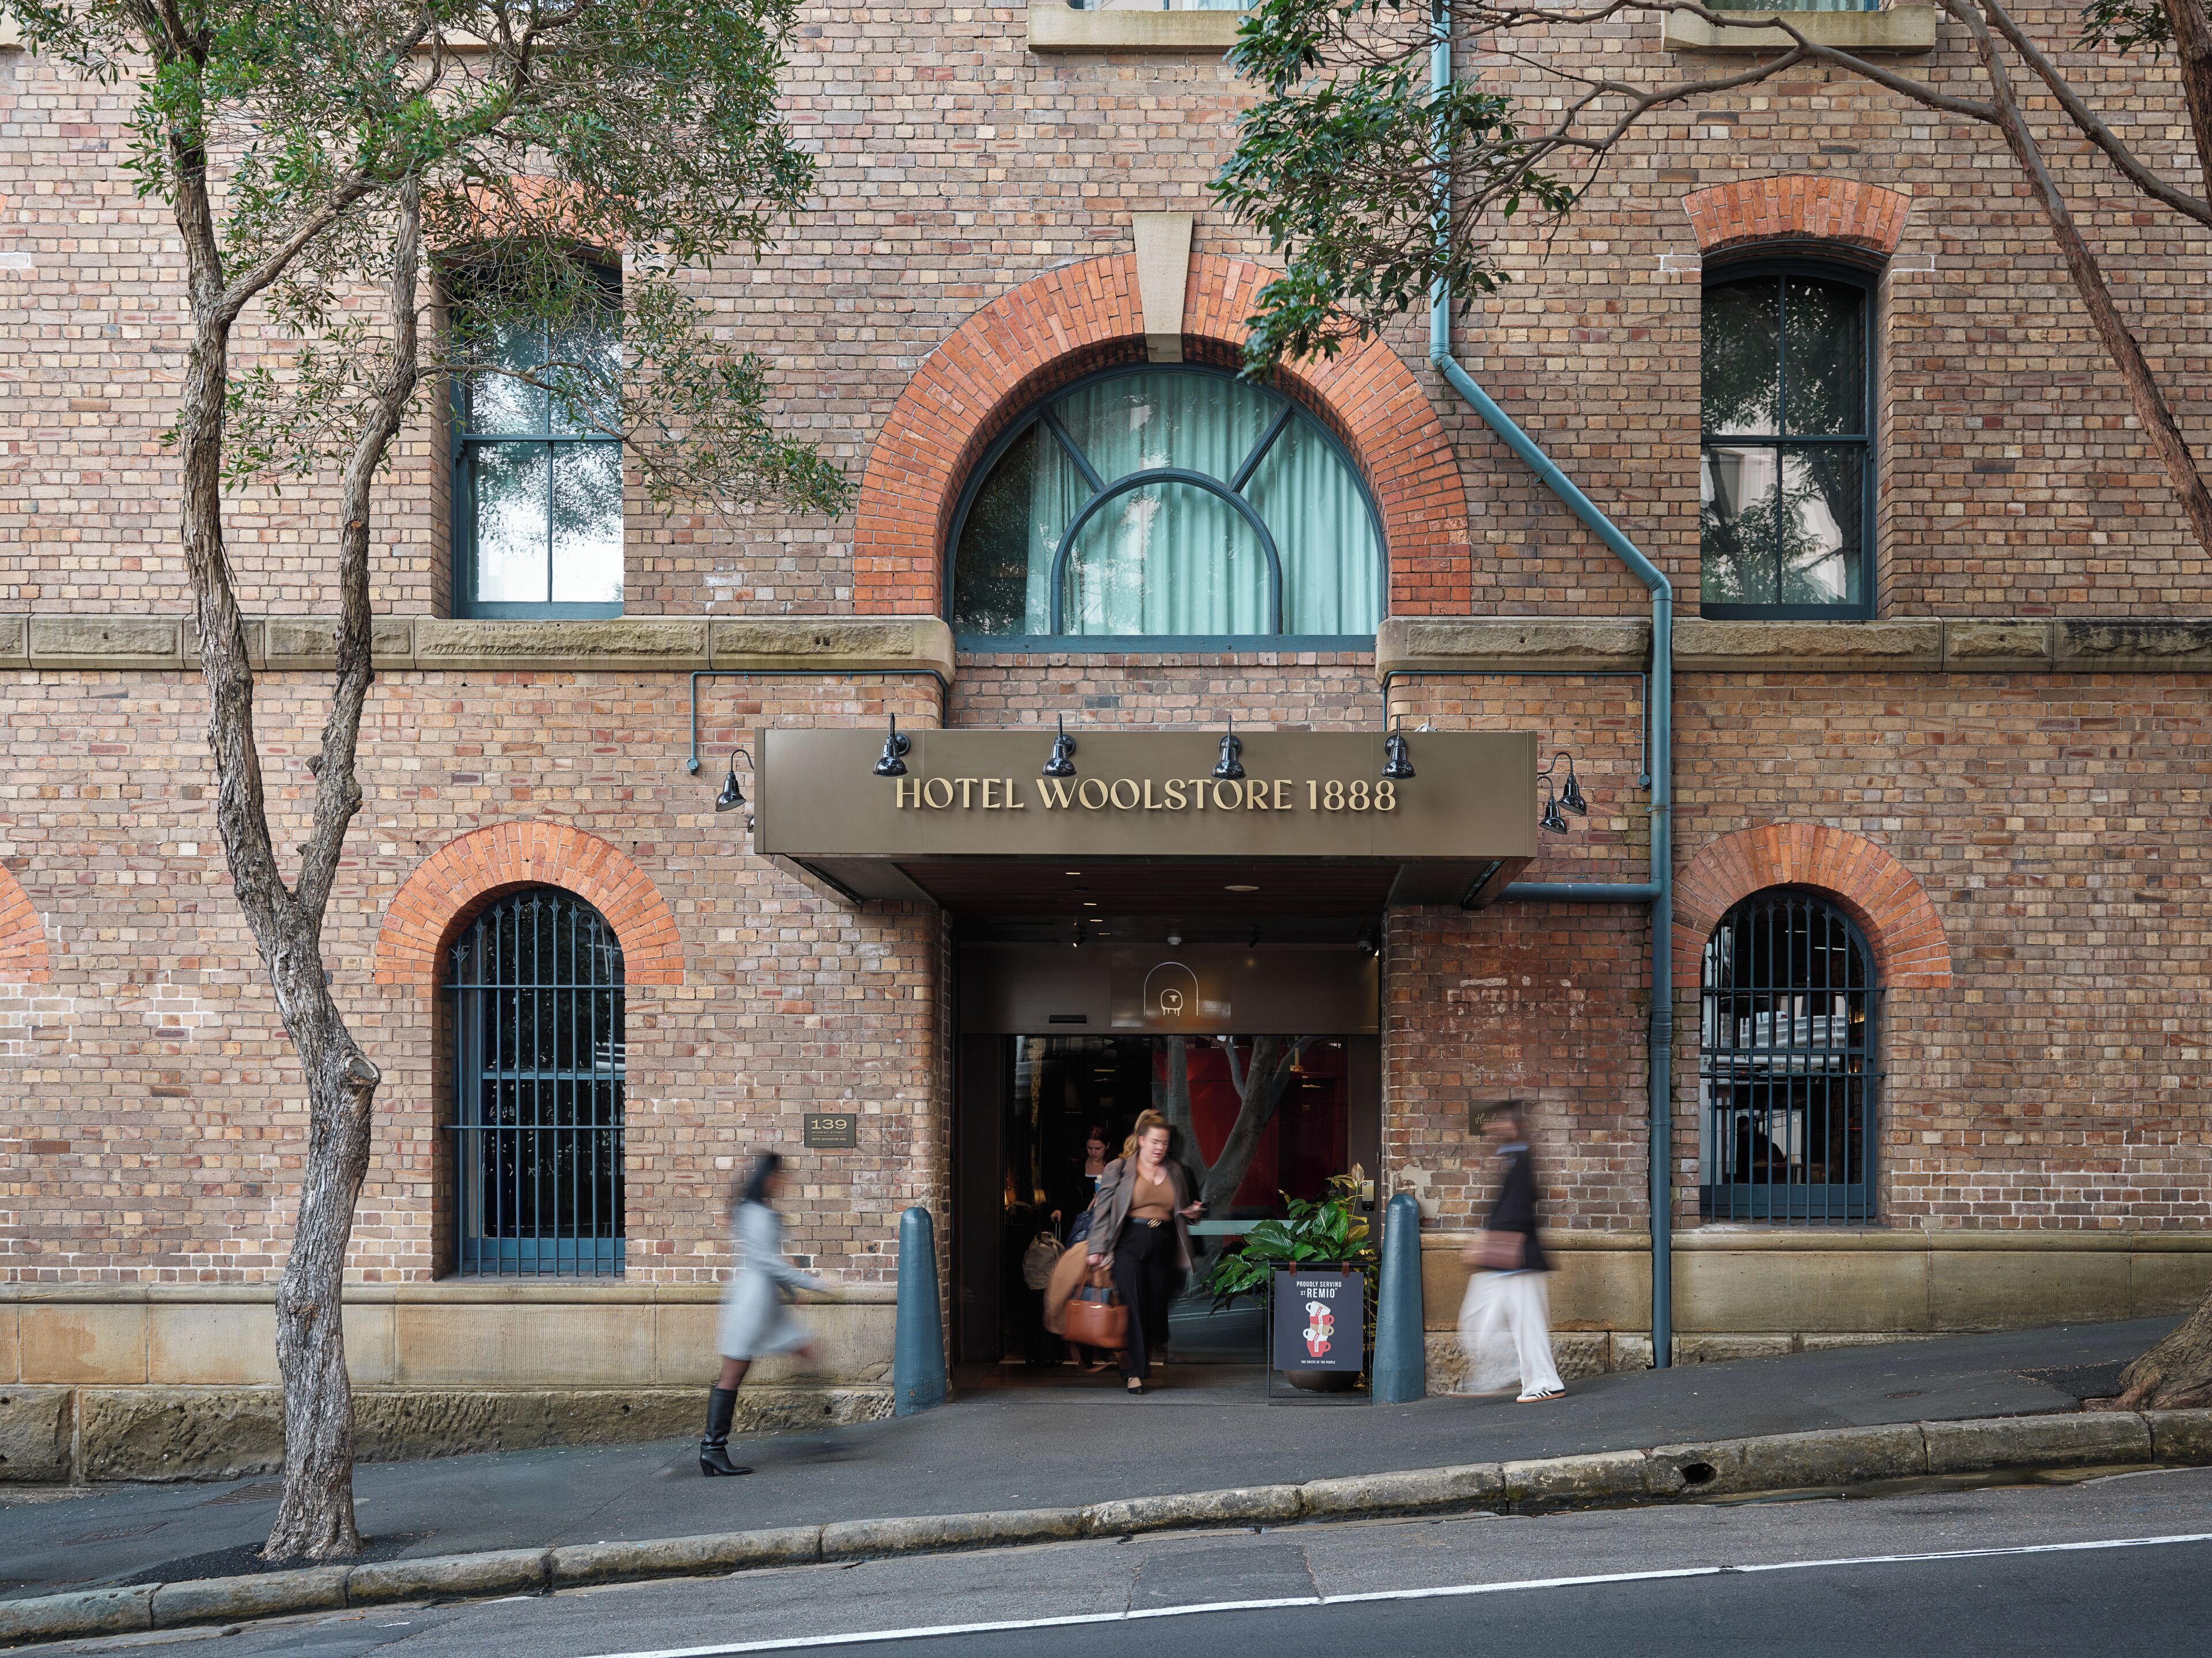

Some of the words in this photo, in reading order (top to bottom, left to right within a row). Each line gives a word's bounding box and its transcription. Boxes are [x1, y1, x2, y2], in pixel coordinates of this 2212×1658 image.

[896, 777, 1025, 809] HOTEL
[1036, 778, 1293, 810] WOOLSTORE
[1306, 780, 1396, 811] 1888
[811, 1119, 847, 1129] 139
